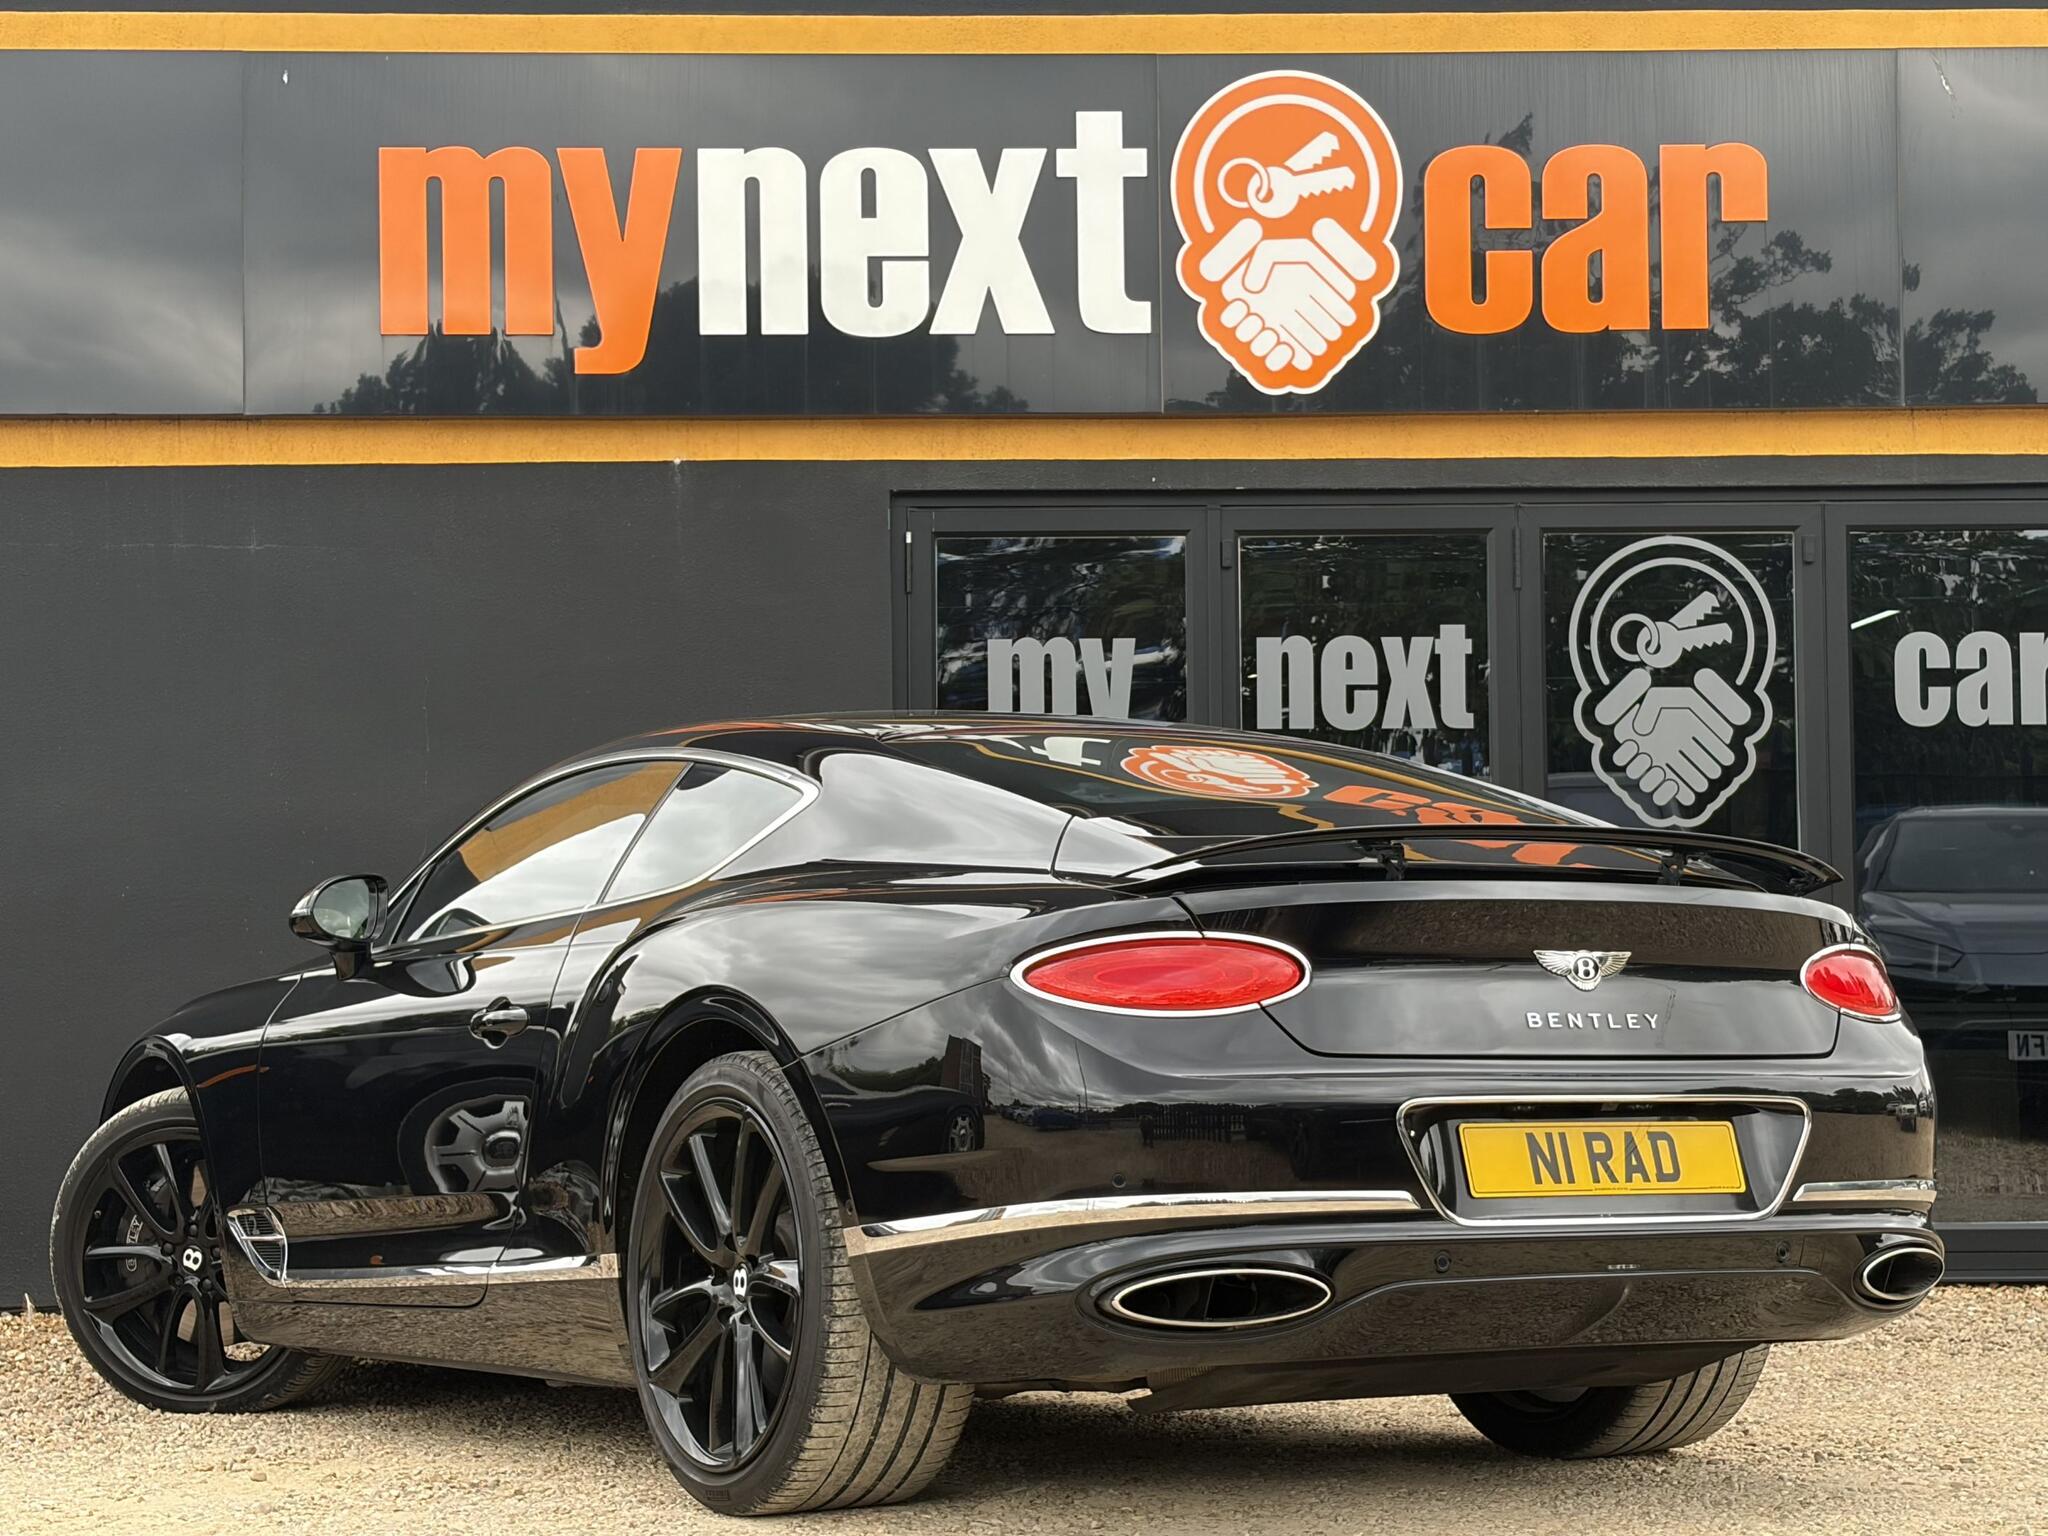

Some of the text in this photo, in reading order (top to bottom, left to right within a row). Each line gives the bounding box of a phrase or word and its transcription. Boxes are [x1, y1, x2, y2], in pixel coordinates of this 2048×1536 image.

[1424, 142, 1768, 335] car
[1256, 624, 1474, 730] next
[1577, 959, 1597, 979] B
[1526, 1012, 1659, 1029] BENTLEY
[1583, 1130, 1681, 1184] RAD
[182, 1248, 203, 1271] B
